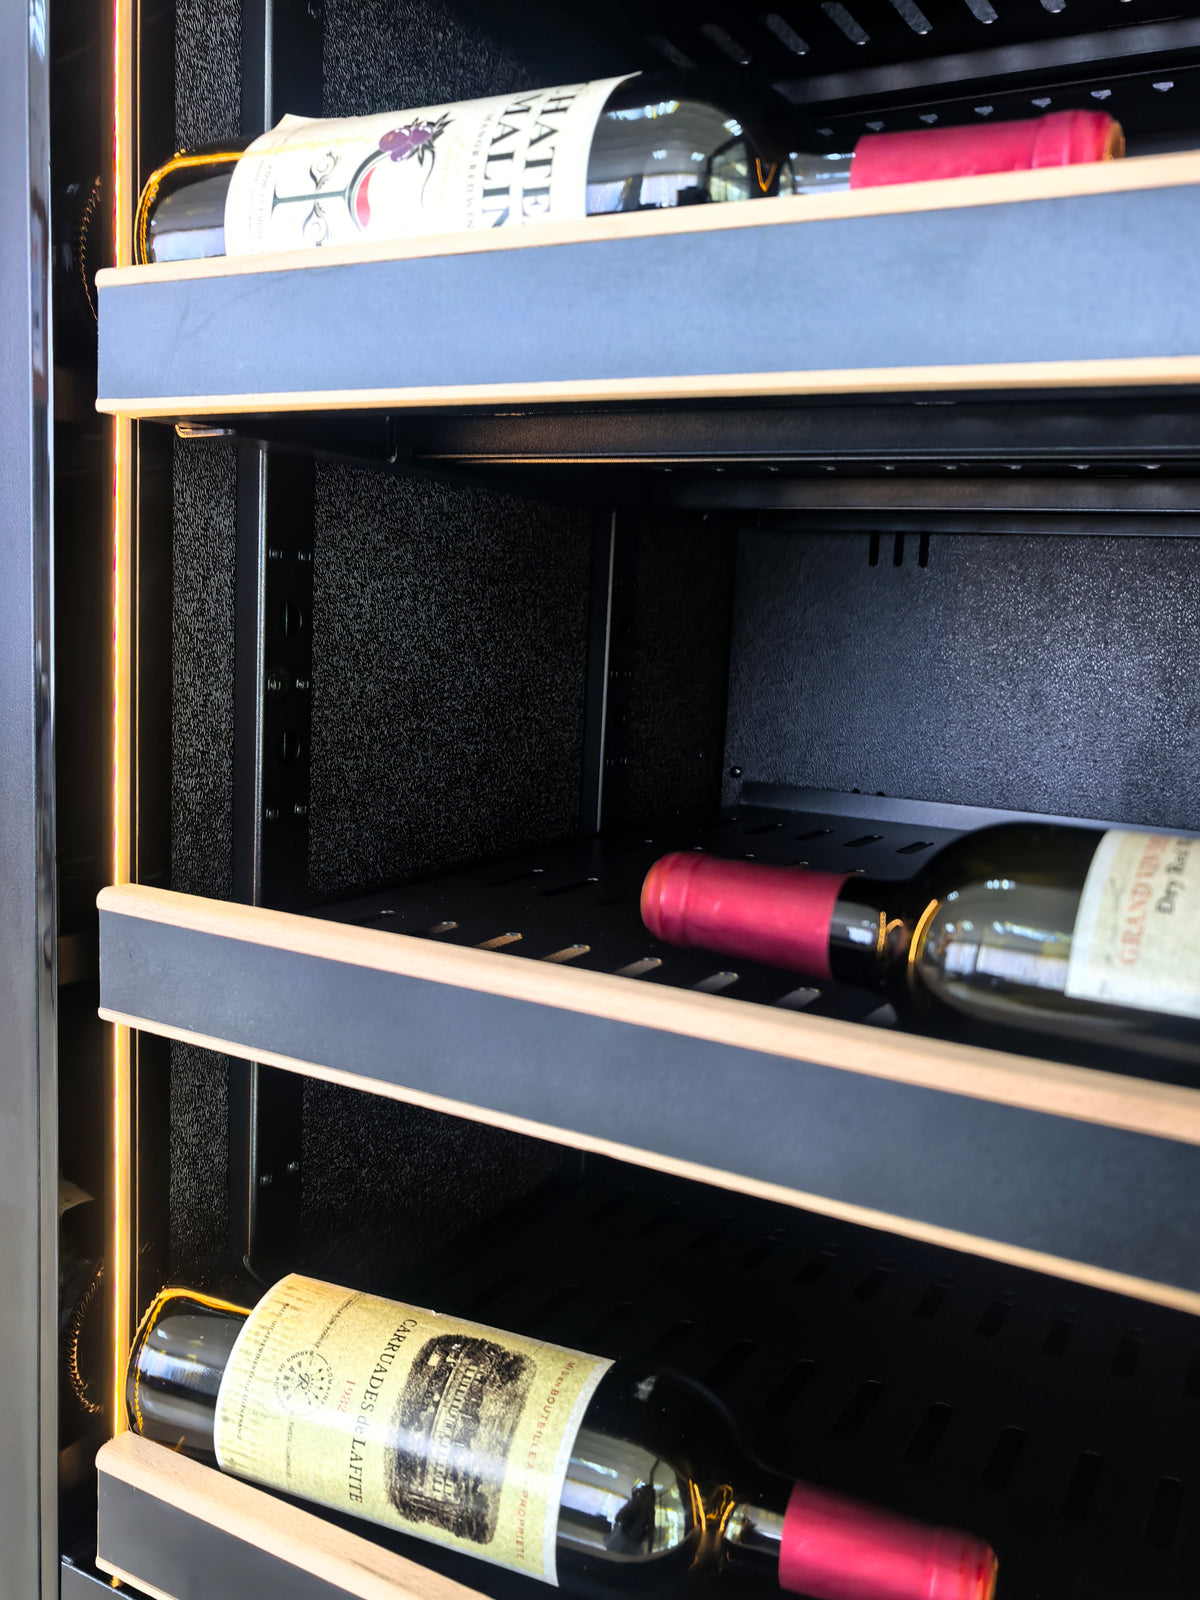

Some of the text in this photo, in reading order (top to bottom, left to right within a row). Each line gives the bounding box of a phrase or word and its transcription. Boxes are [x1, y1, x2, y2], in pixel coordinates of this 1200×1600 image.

[521, 94, 576, 218] HATE
[1118, 882, 1152, 966] GRAND
[337, 1380, 356, 1413] 1982
[348, 1318, 417, 1503] CARRUADES de LAFITE
[528, 1388, 560, 1460] BOUTEILLE
